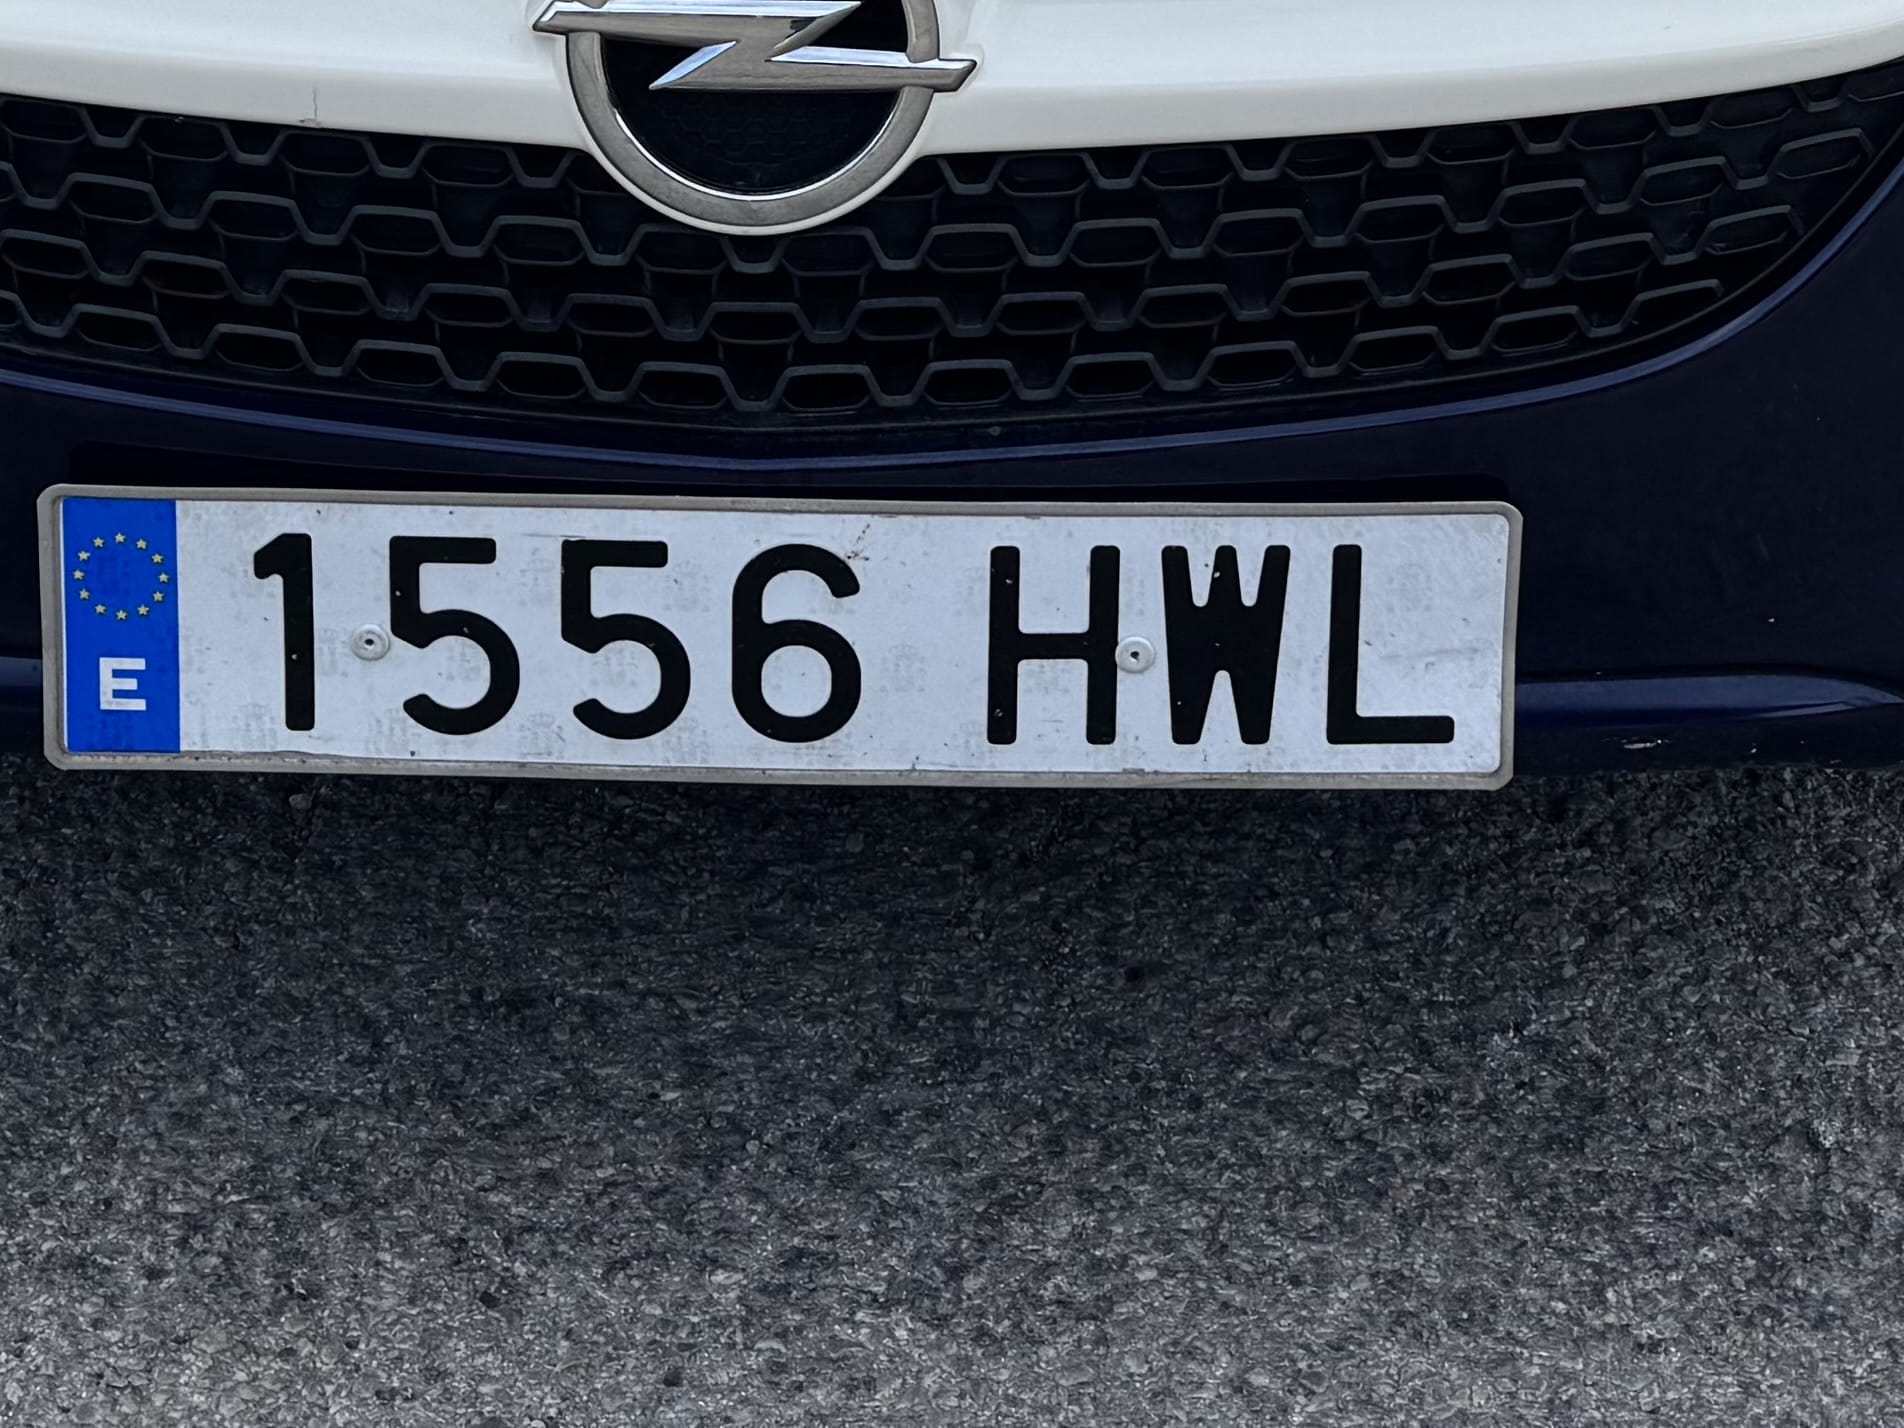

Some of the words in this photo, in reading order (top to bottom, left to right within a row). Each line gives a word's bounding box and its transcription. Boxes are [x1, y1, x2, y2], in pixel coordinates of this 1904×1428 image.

[99, 657, 146, 711] E
[253, 532, 862, 743] 1556
[986, 544, 1455, 744] HWL
